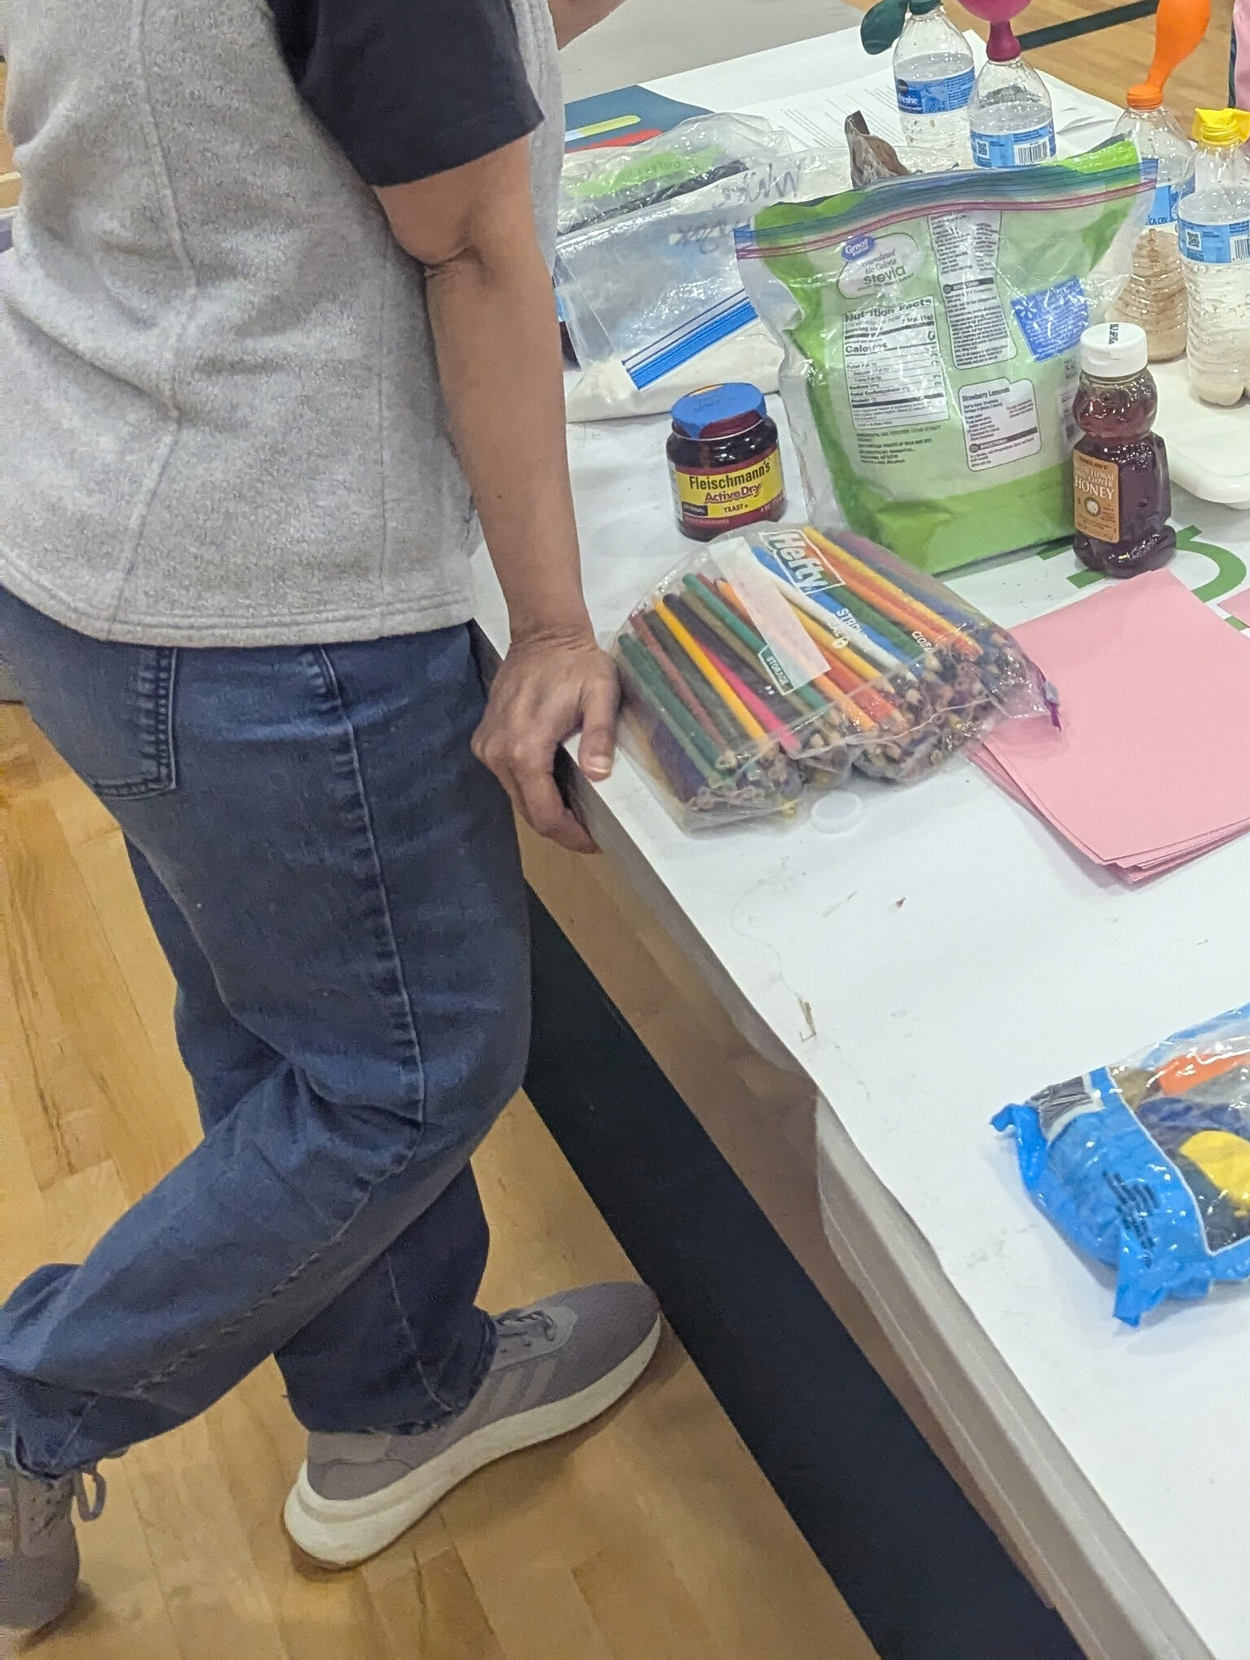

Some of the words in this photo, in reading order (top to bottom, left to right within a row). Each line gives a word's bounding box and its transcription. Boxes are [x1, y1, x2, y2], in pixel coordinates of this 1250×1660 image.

[844, 239, 869, 254] Great
[863, 265, 906, 285] stevia
[689, 460, 771, 490] Fleischmann's
[1075, 475, 1115, 499] HONEY
[769, 533, 828, 591] Hefty
